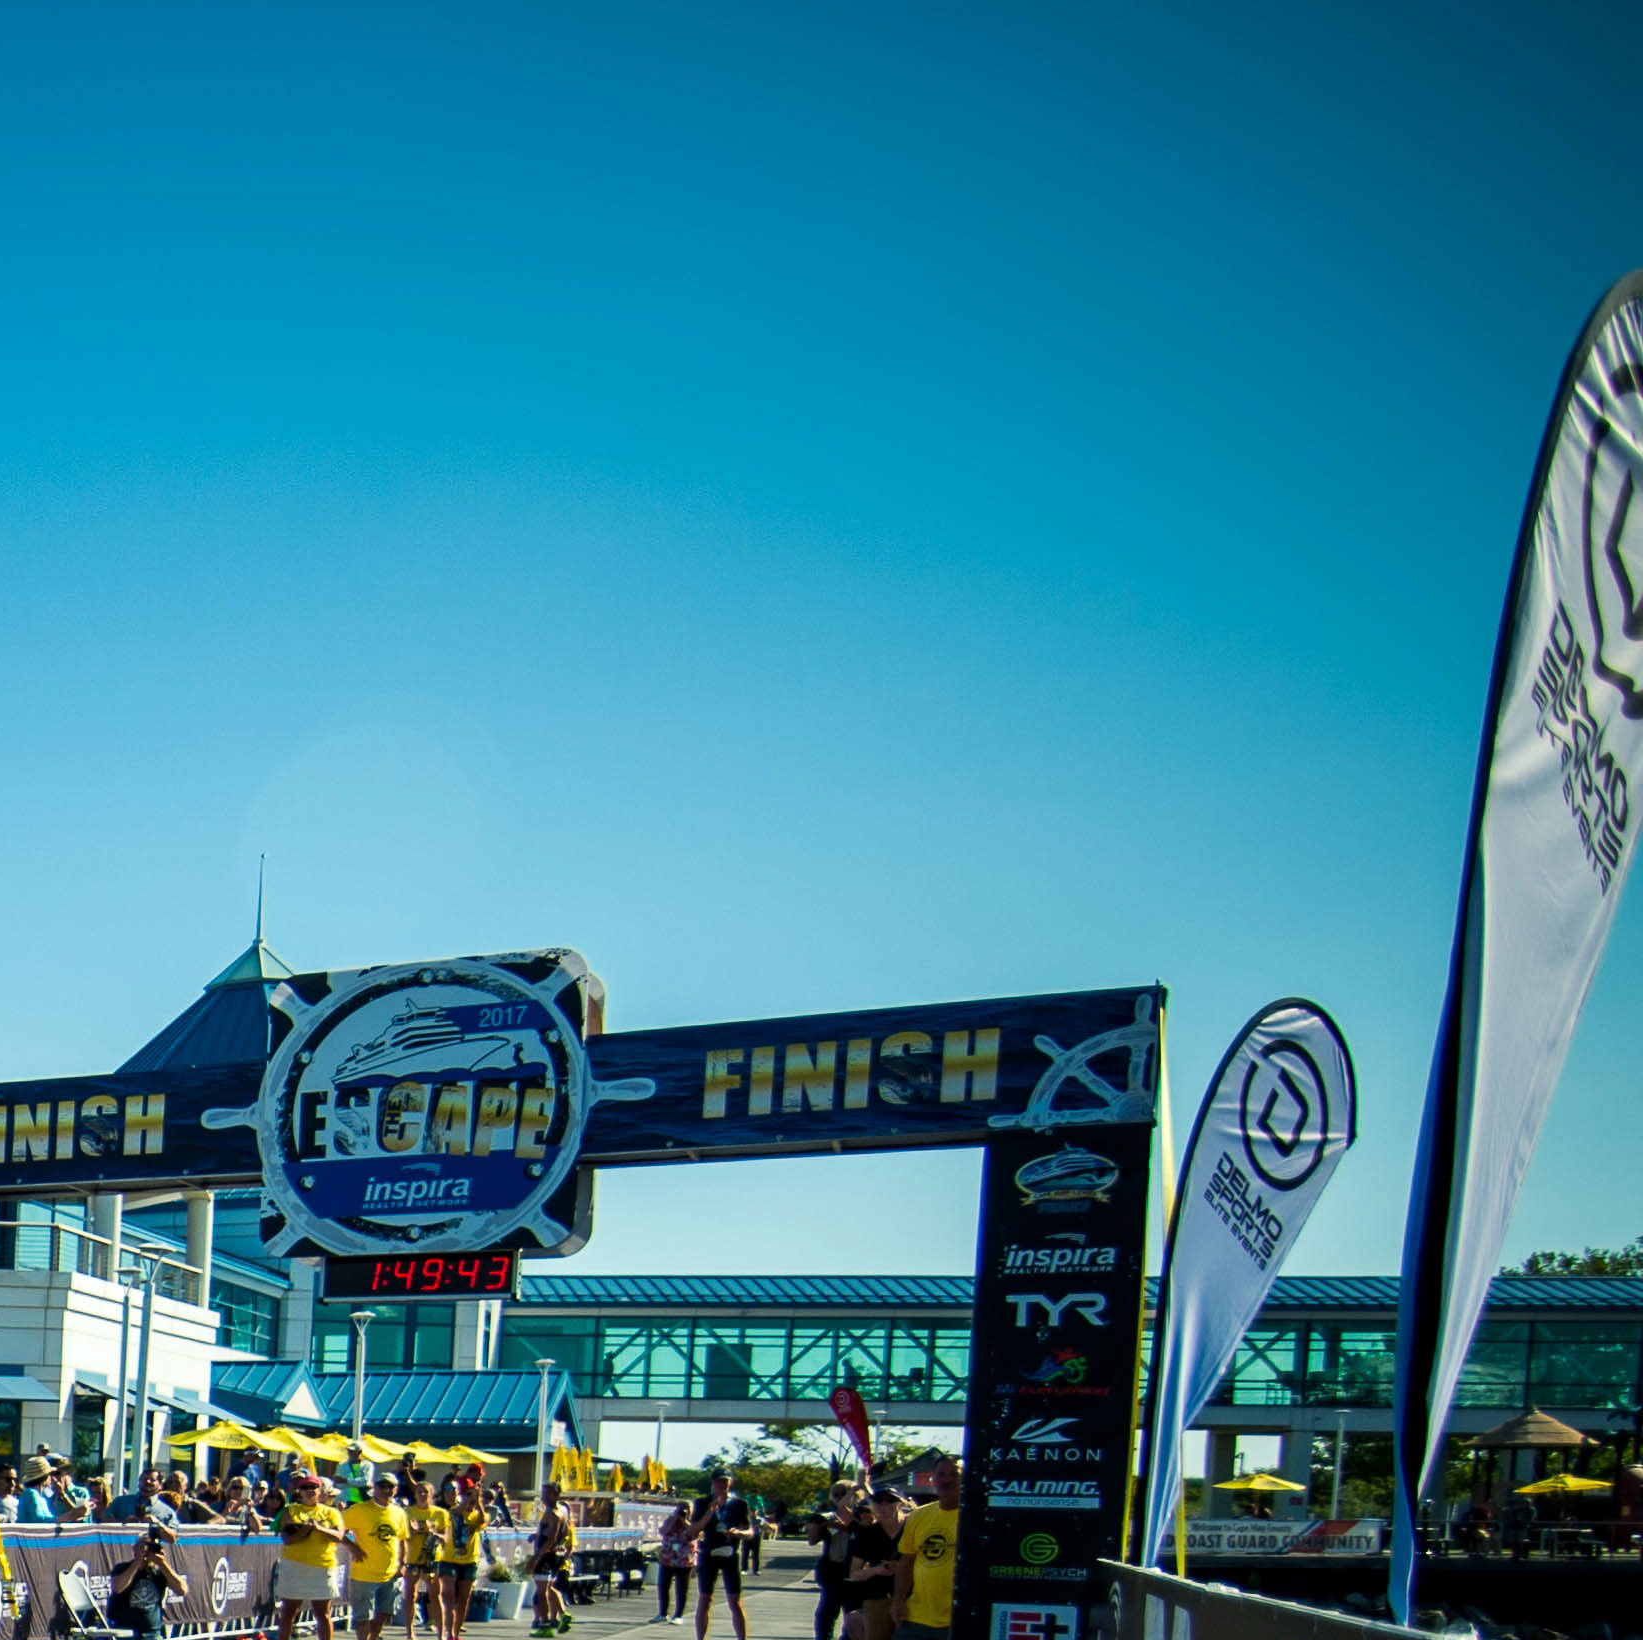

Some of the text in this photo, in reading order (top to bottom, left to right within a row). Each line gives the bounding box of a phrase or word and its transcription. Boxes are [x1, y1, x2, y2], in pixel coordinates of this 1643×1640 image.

[478, 1005, 528, 1028] 2017
[702, 1028, 1001, 1119] FINISH
[298, 1080, 555, 1161] ESCAPE
[365, 1177, 470, 1208] inspira
[1217, 1151, 1283, 1241] DELMO
[1208, 1172, 1275, 1259] SPORTS
[371, 1256, 510, 1291] 1:49:43
[1005, 1244, 1115, 1273] inspira
[1005, 1293, 1110, 1328] TYR
[1185, 1534, 1222, 1549] OAST
[1226, 1533, 1277, 1549] GUARD
